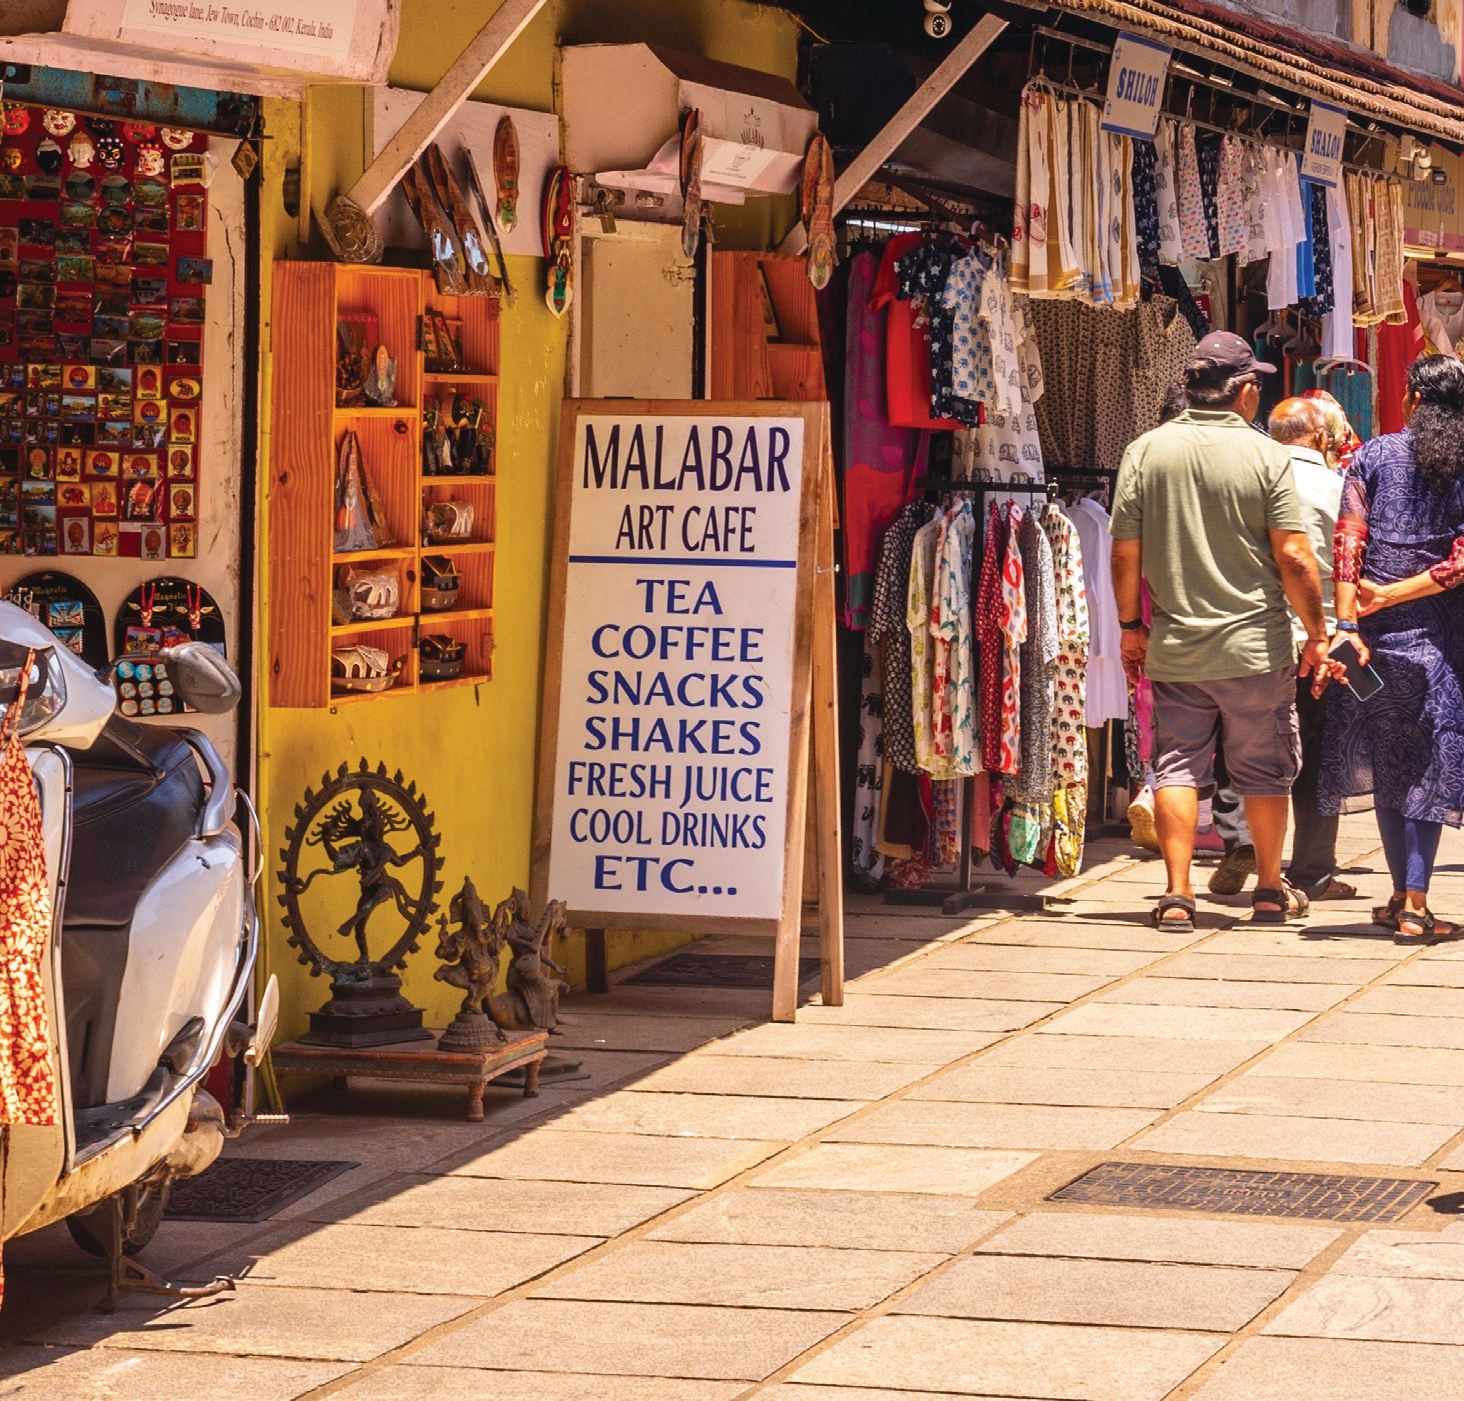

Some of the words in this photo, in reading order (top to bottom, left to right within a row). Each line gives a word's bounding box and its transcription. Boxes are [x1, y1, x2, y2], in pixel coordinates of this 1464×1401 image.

[149, 1, 188, 22] Synagogue
[188, 2, 204, 24] lane,
[205, 4, 218, 22] Jew
[220, 7, 240, 28] Town,
[241, 10, 264, 30] Cochin
[269, 14, 281, 32] 682
[318, 21, 334, 40] India
[1116, 67, 1160, 107] SHILOH
[583, 424, 791, 493] MALABAR
[615, 505, 674, 550] ART
[682, 505, 756, 552] CAFE
[636, 579, 723, 615] TEA
[591, 624, 764, 663] COFFEE
[586, 670, 764, 709] SNACKS
[584, 716, 761, 756] SHAKES
[567, 762, 672, 799] FRESH
[679, 765, 774, 809] JUICE
[569, 808, 652, 845] COOL
[661, 811, 766, 849] DRINKS
[594, 855, 737, 895] ETC...
